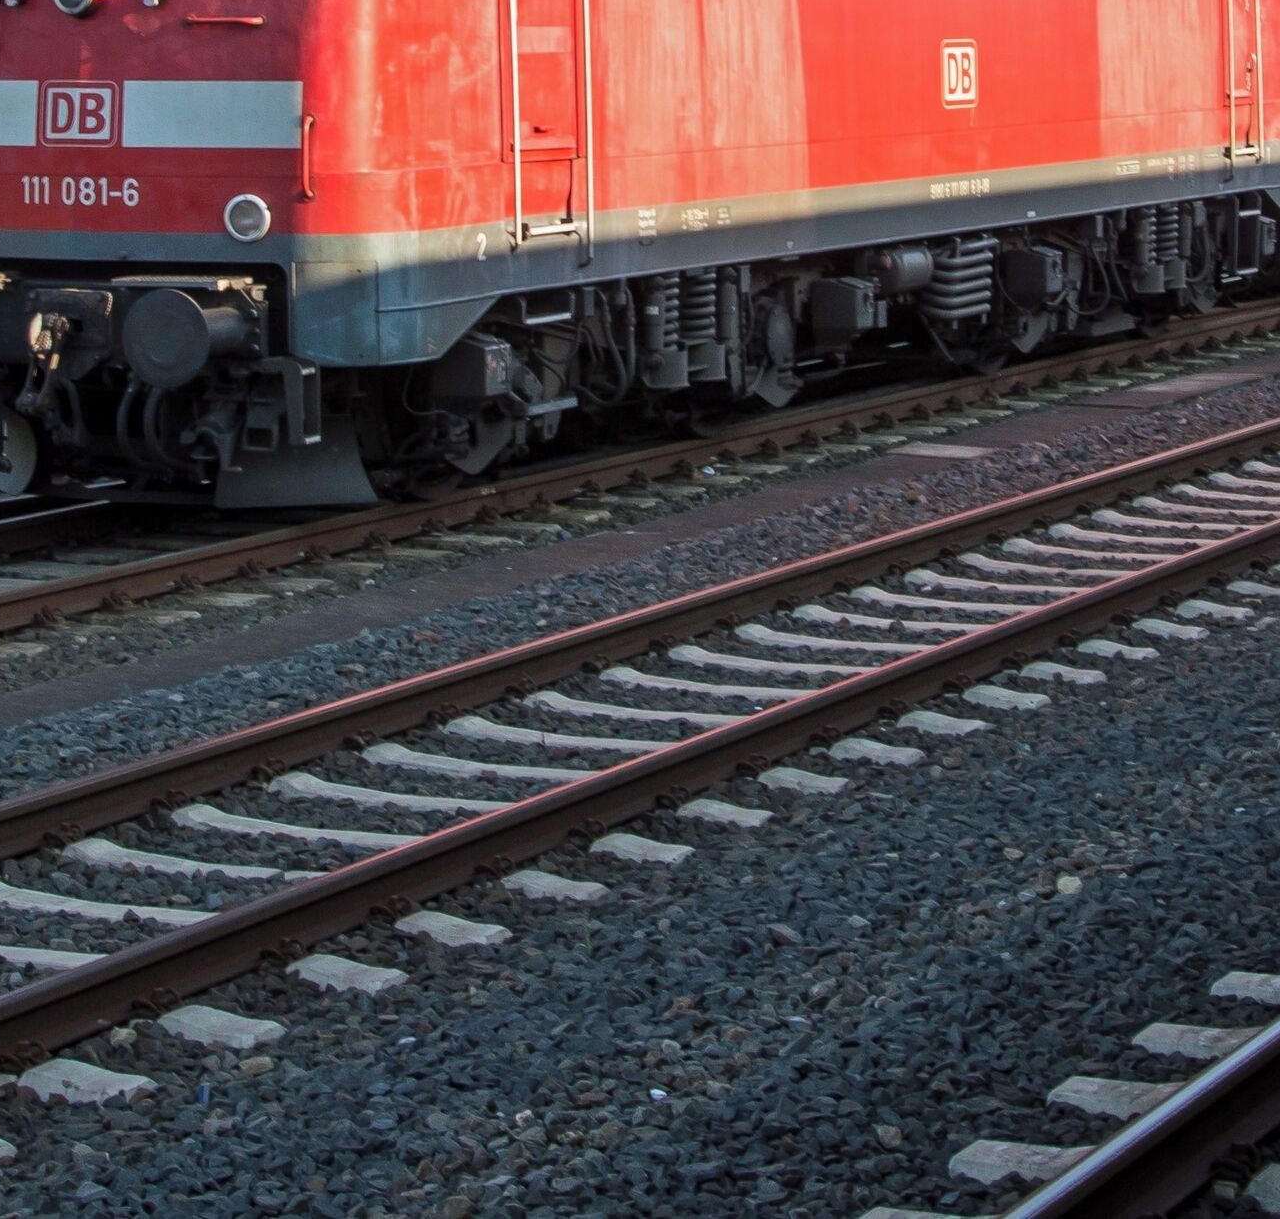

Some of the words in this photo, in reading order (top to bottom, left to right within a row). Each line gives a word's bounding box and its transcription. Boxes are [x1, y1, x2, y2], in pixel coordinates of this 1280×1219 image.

[947, 52, 972, 95] DB
[50, 91, 107, 135] DB
[21, 175, 50, 205] 111
[61, 176, 140, 207] 081-6
[476, 232, 488, 262] 2
